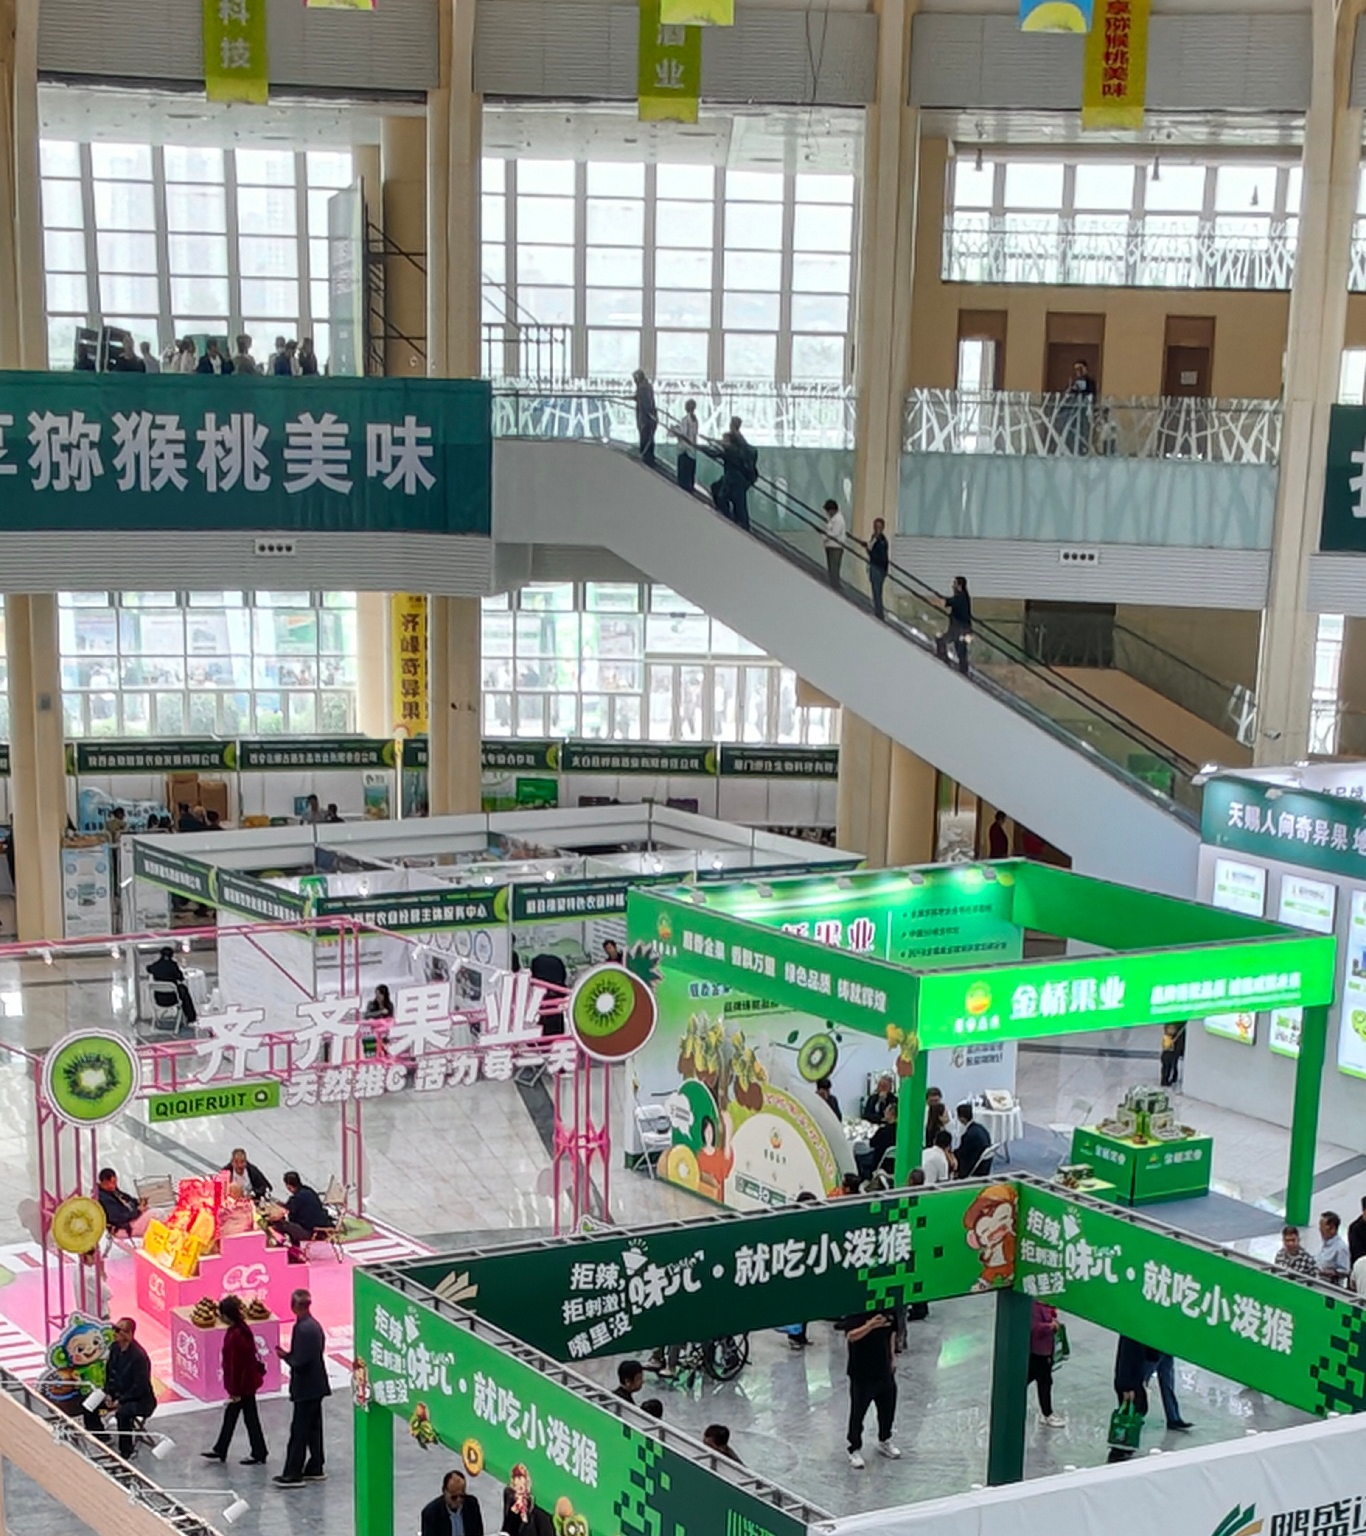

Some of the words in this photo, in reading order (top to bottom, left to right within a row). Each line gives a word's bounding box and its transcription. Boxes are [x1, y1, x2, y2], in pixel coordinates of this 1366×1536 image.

[194, 972, 547, 1083] 齐齐果业
[155, 1090, 247, 1118] QIQIFRUIT
[283, 1063, 408, 1107] 天然维C
[414, 1040, 576, 1092] 活力每一天
[734, 1223, 912, 1289] 就吃小泼猴
[1142, 1261, 1295, 1356] 就吃小泼猴
[473, 1371, 600, 1489] 就吃小泼猴
